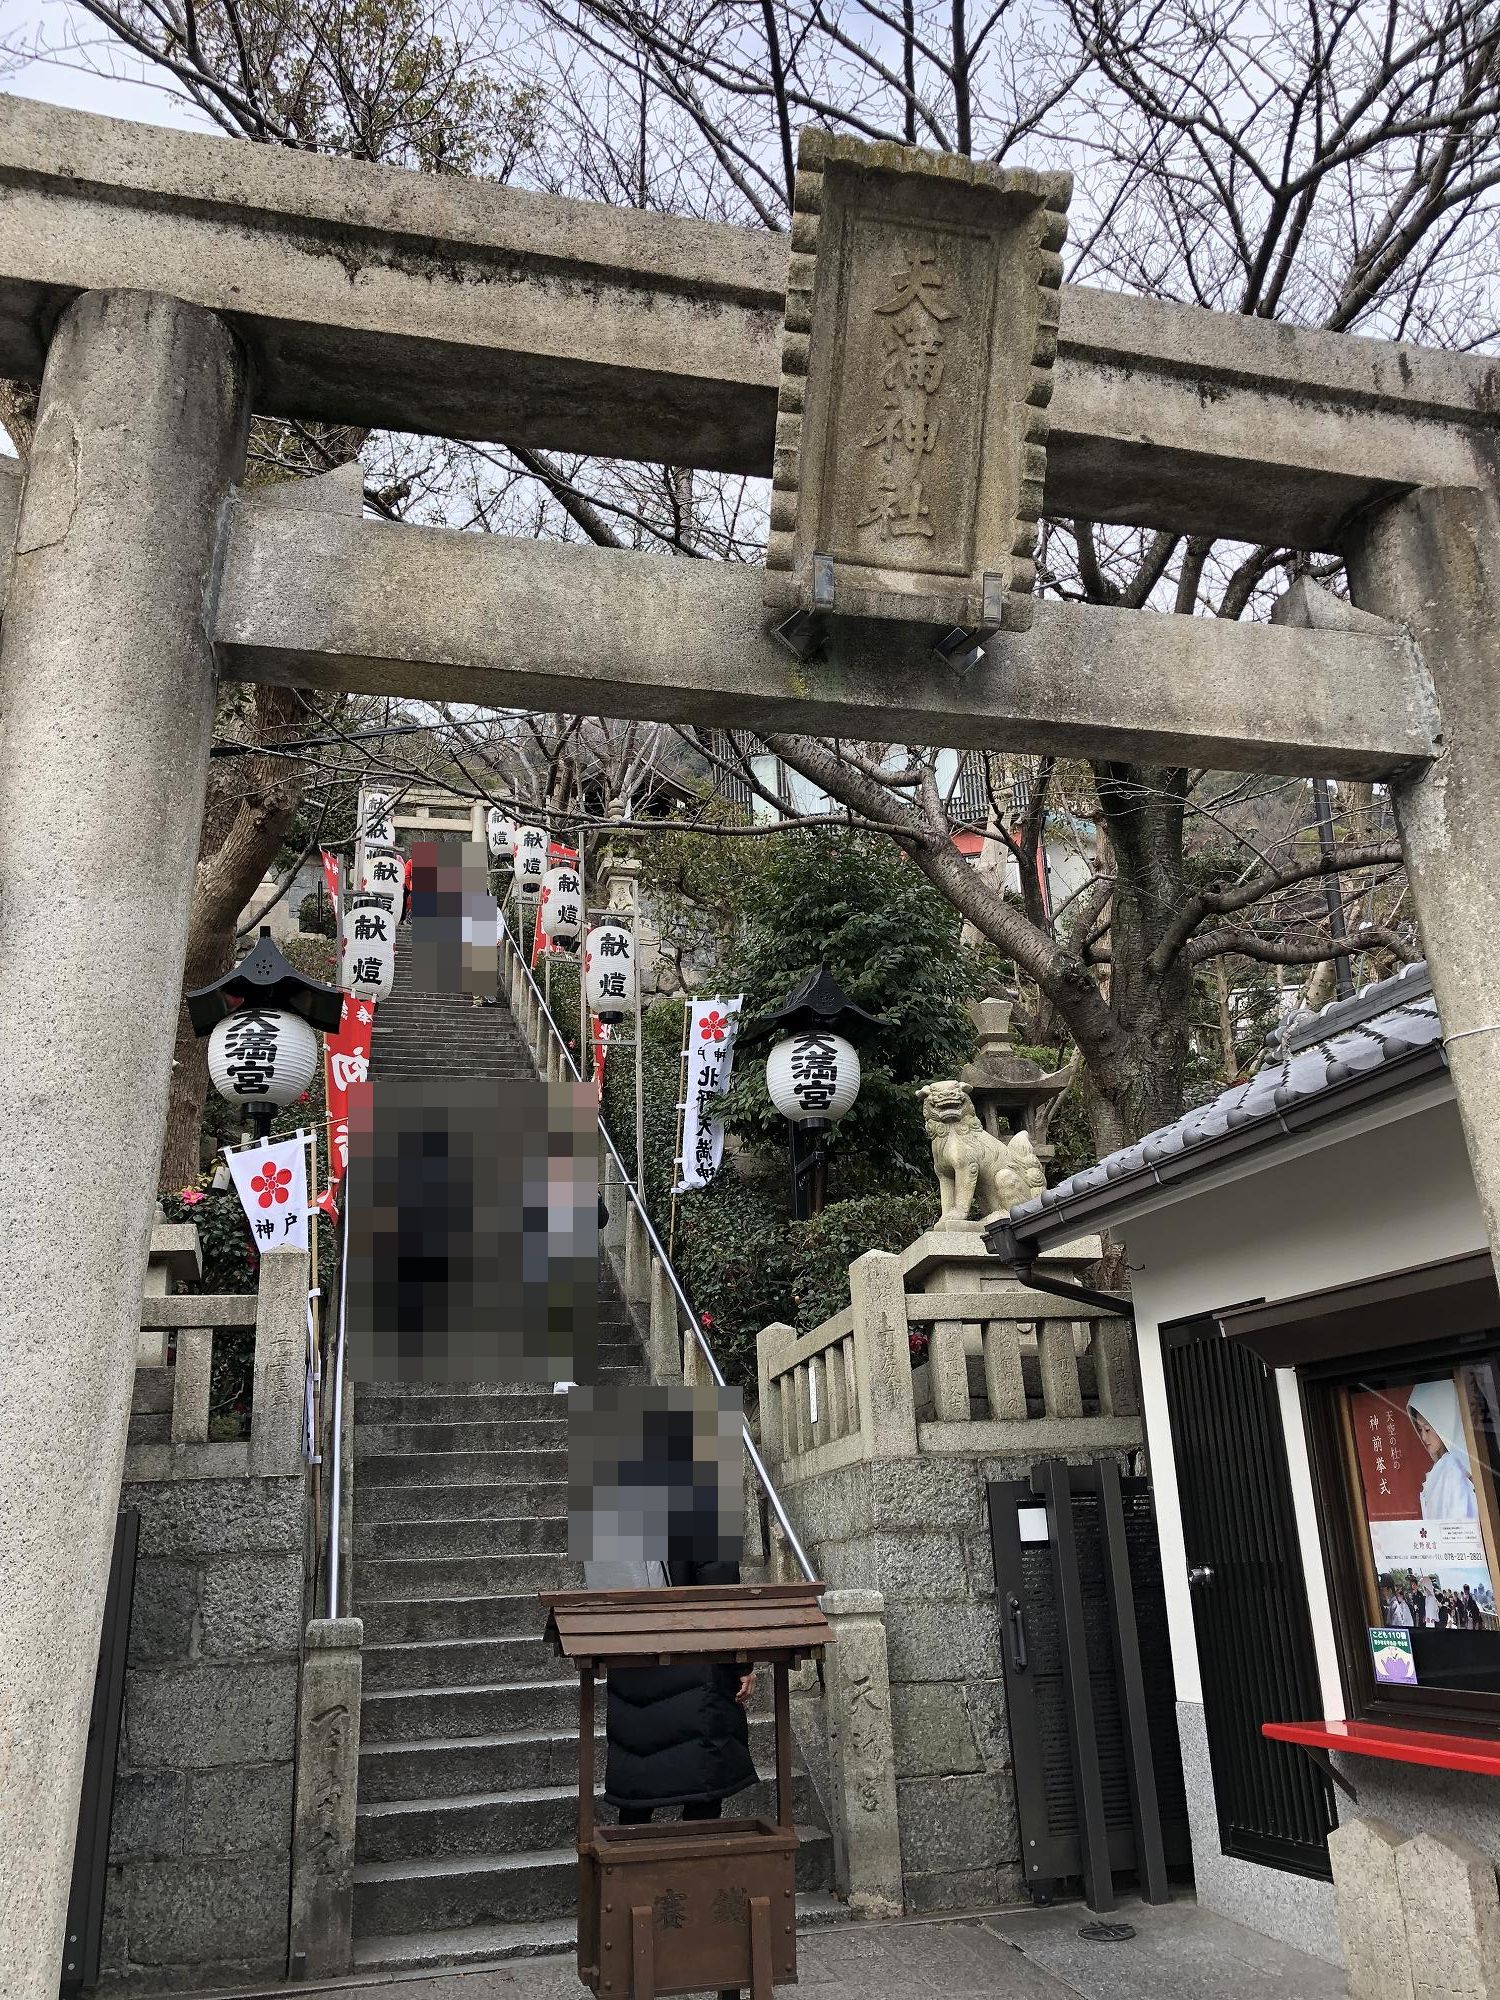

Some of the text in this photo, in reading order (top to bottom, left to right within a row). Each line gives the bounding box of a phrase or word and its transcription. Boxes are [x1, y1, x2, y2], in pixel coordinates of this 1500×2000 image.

[523, 831, 544, 876] 献燈
[557, 873, 580, 927] 献燈
[352, 914, 388, 986] 献燈
[599, 932, 630, 998] 献燈
[225, 1010, 281, 1095] 天満宮
[791, 1032, 839, 1111] 天満宮
[255, 1212, 298, 1240] 神戸
[1369, 1414, 1391, 1495] 神前挙式
